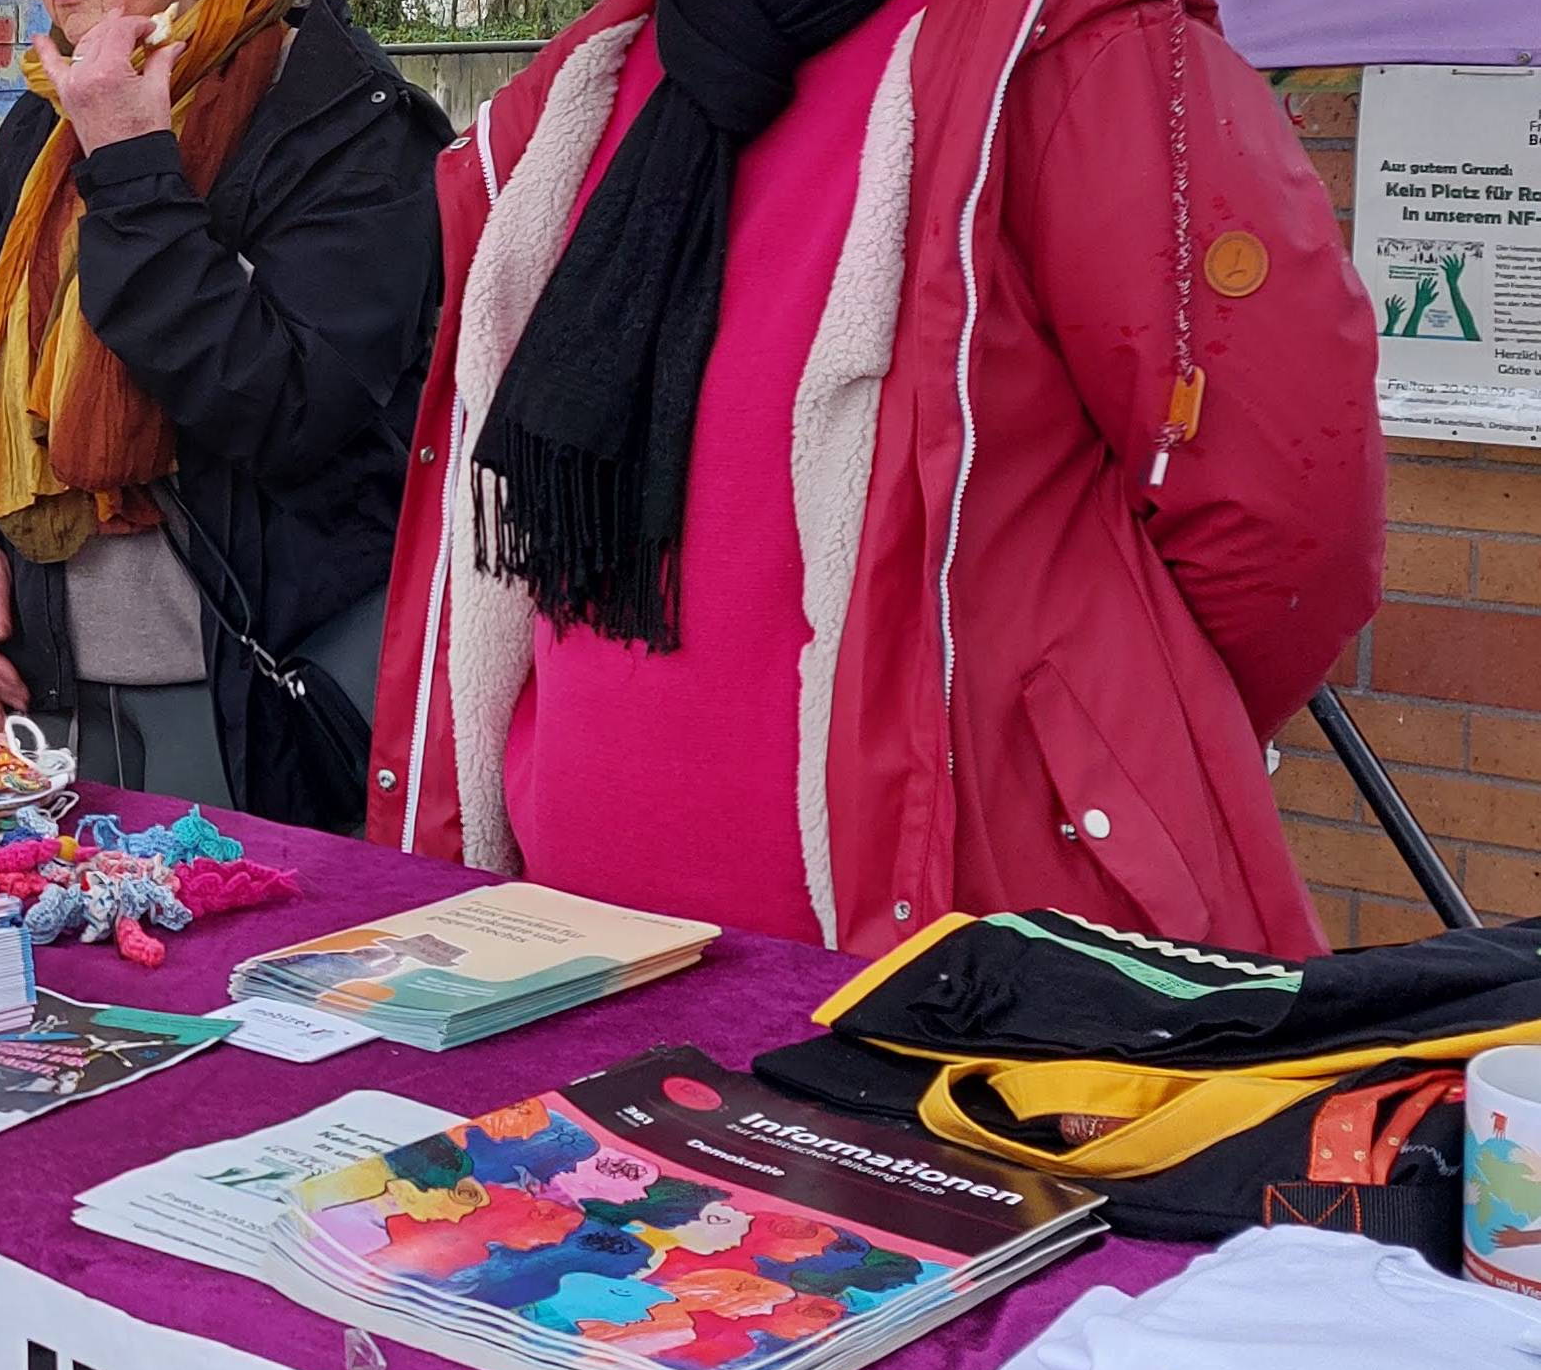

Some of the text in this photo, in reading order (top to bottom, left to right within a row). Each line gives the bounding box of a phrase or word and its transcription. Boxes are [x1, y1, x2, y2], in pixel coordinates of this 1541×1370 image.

[1380, 160, 1513, 176] Aus gutem Grund:
[1385, 182, 1426, 198] Kein
[1431, 184, 1480, 200] Platz
[1485, 185, 1512, 201] für
[1402, 206, 1419, 221] In
[1425, 210, 1502, 225] unserem
[685, 1138, 787, 1178] Demokratie
[725, 1123, 751, 1137] zur
[750, 1132, 838, 1163] politischen
[838, 1157, 901, 1184] Bildung
[738, 1113, 1024, 1206] Informationen
